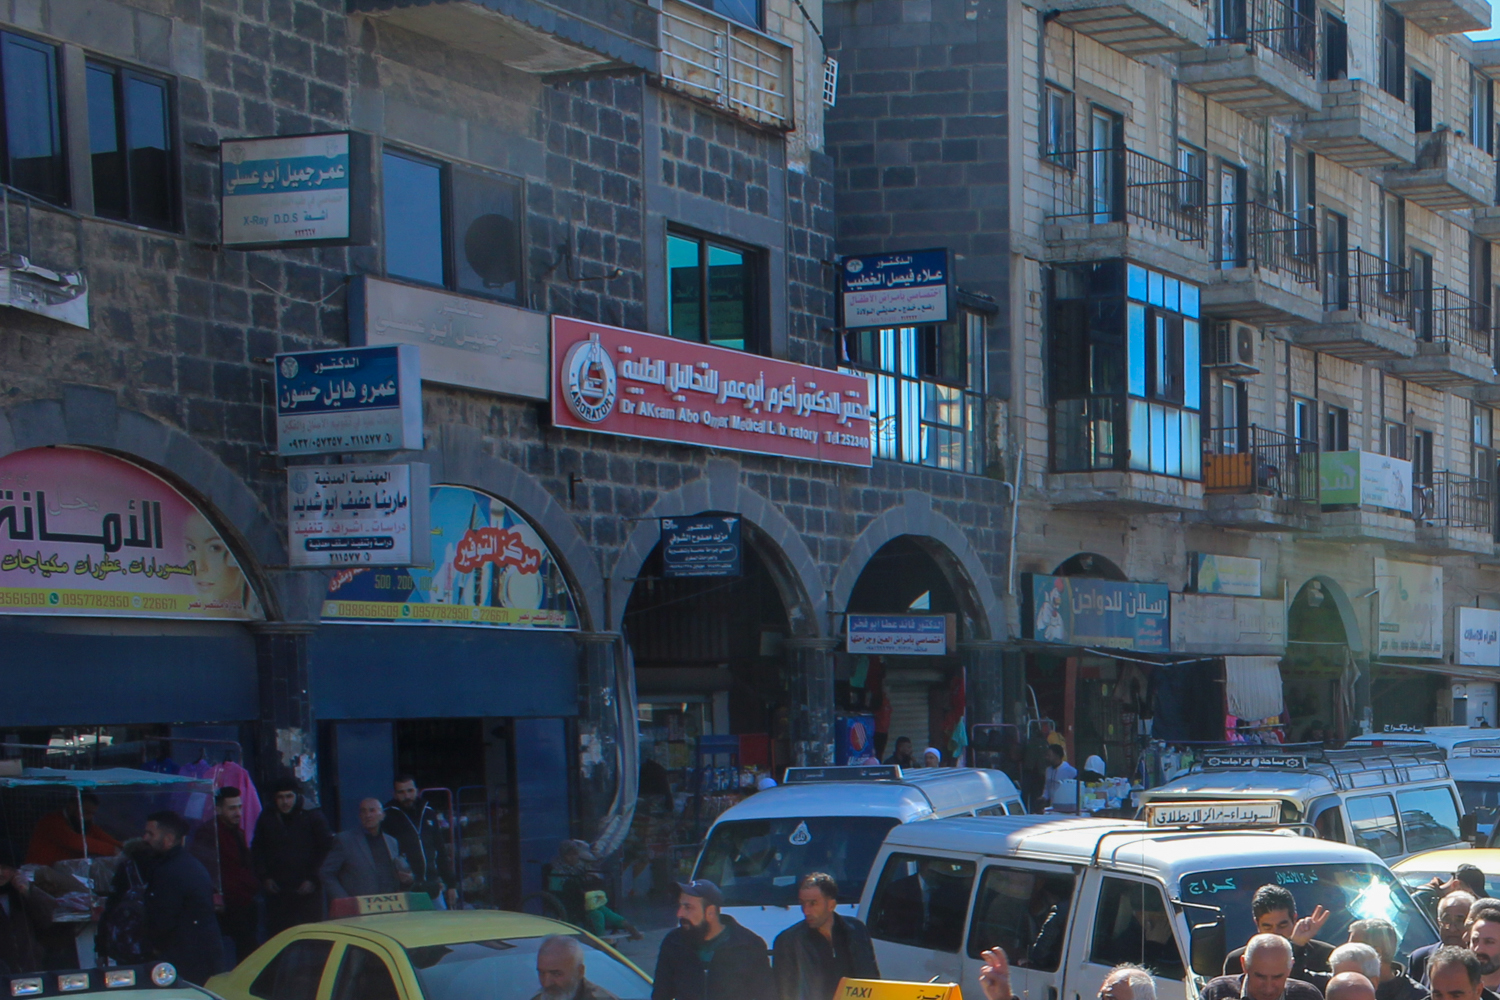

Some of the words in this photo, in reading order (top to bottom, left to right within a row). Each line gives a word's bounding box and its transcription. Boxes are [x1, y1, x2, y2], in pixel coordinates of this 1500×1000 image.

[226, 169, 260, 194] عسلي
[261, 160, 279, 189] أبو
[281, 163, 315, 188] جميل
[314, 164, 345, 186] عمر
[243, 216, 269, 227] X-Ray
[273, 213, 299, 224] D.D.S
[876, 256, 913, 269] الدكتور
[846, 271, 886, 290] الخطيب
[886, 268, 915, 287] فيصل
[916, 268, 943, 283] علاء
[314, 357, 359, 374] الدكتور
[617, 345, 666, 395] الطبية
[323, 379, 357, 407] هايل
[569, 383, 615, 420] LABORATORY
[715, 380, 747, 405] عمر
[743, 370, 765, 414] أبو
[764, 376, 797, 414] أكرم
[793, 381, 841, 418] الدكتور
[620, 399, 636, 415] Dr
[676, 407, 701, 424] Abo
[729, 414, 766, 434] Medical
[314, 470, 349, 489] المدنية
[351, 470, 391, 486] المهندسة
[48, 485, 99, 516] محل
[340, 490, 372, 516] عفيف
[374, 489, 408, 517] مارينا
[0, 490, 164, 553] الأمانة
[294, 521, 324, 537] تنفيذ
[331, 521, 363, 536] اشراف
[371, 521, 407, 534] دراسات
[458, 536, 497, 568] التوفير
[496, 536, 538, 569] مركز
[1, 549, 69, 577] مكياجات
[375, 575, 391, 590] 500
[62, 594, 130, 608] 0957782950
[142, 597, 177, 610] 226671
[1072, 587, 1122, 616] للدواجن
[1125, 590, 1168, 619] رسلان
[338, 603, 399, 618] 0988561509
[412, 605, 469, 620] 0957782950
[480, 609, 509, 622] 226671
[917, 619, 943, 631] الدكتور
[1220, 757, 1251, 767] كراجات
[1260, 757, 1284, 765] ساحة
[1156, 808, 1203, 824] الانطلاق
[1188, 877, 1237, 895] كراج
[364, 895, 399, 904] TAXI
[845, 986, 873, 999] TAXI
